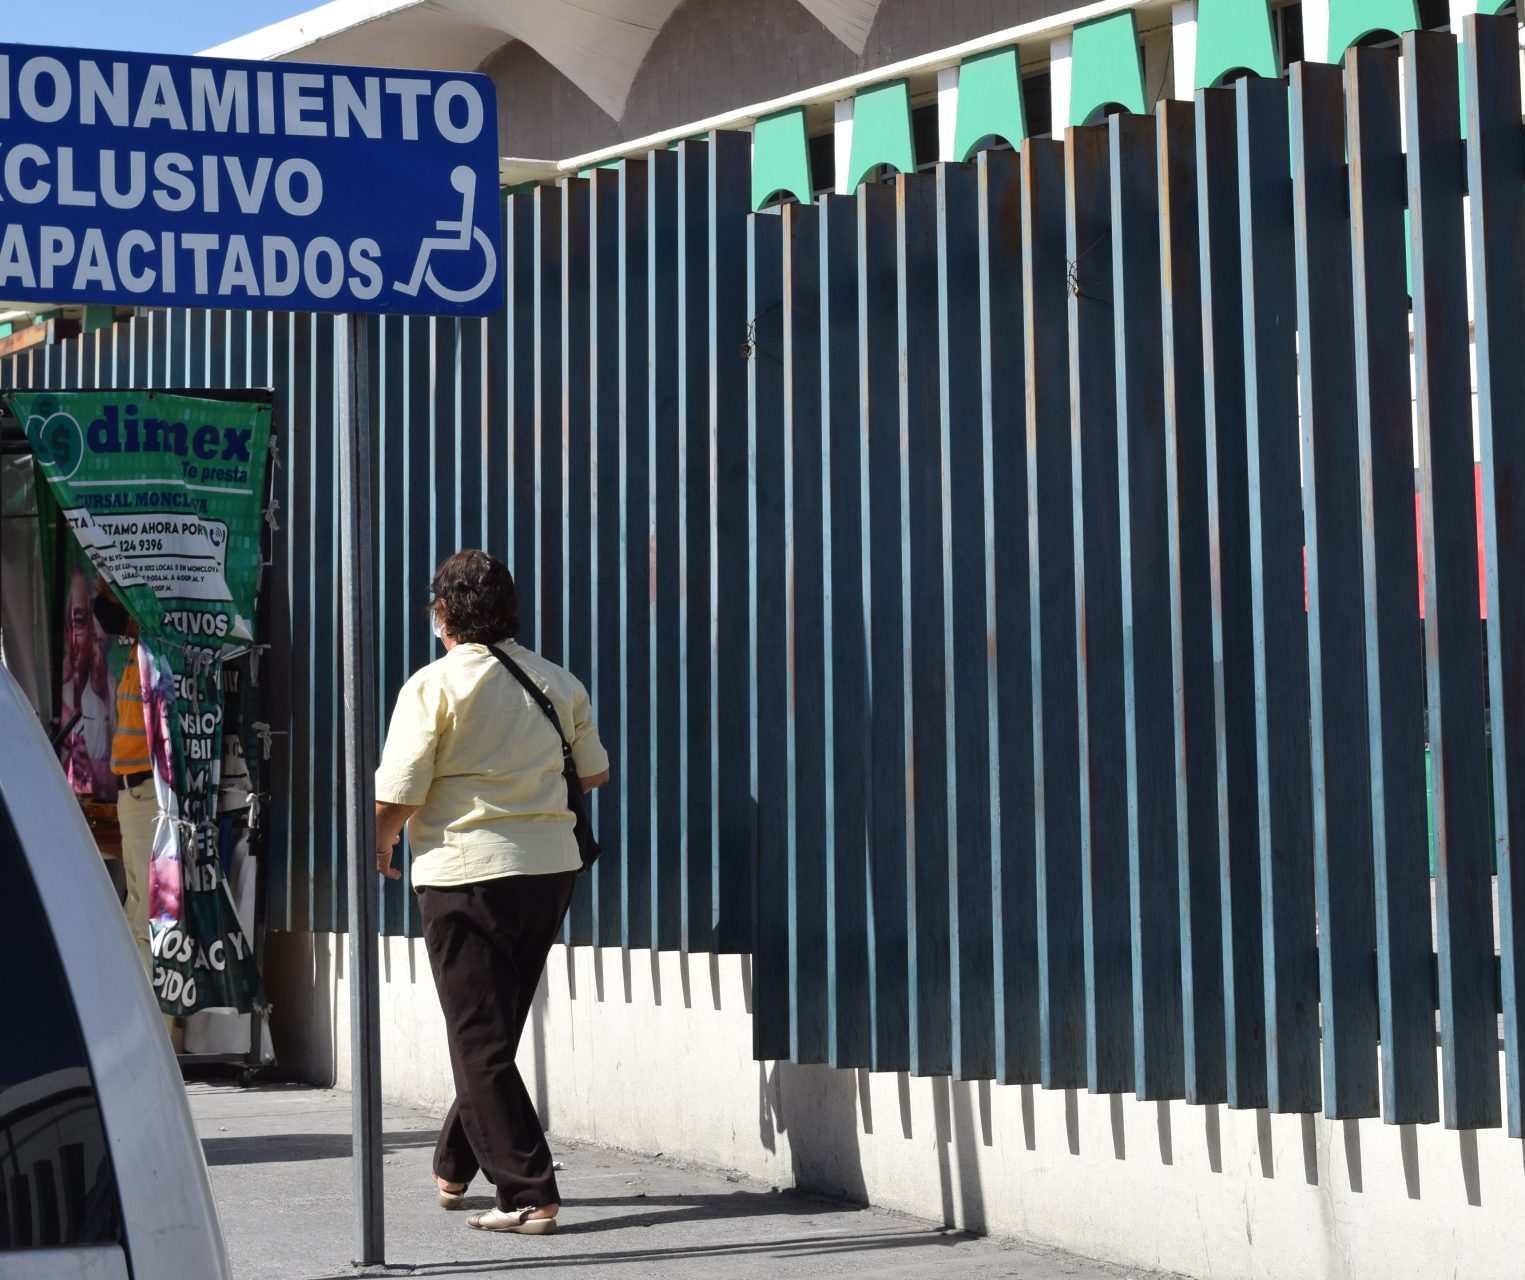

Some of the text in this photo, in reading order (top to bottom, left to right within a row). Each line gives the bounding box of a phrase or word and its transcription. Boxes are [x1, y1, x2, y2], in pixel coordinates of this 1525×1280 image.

[0, 143, 324, 217] CLUSIVO
[0, 223, 384, 301] APACITADOS
[87, 403, 252, 463] dimex
[201, 464, 248, 484] presta
[98, 521, 204, 536] STAMO AHORA POR
[119, 538, 163, 552] 124 9396
[155, 563, 174, 571] LOCAL
